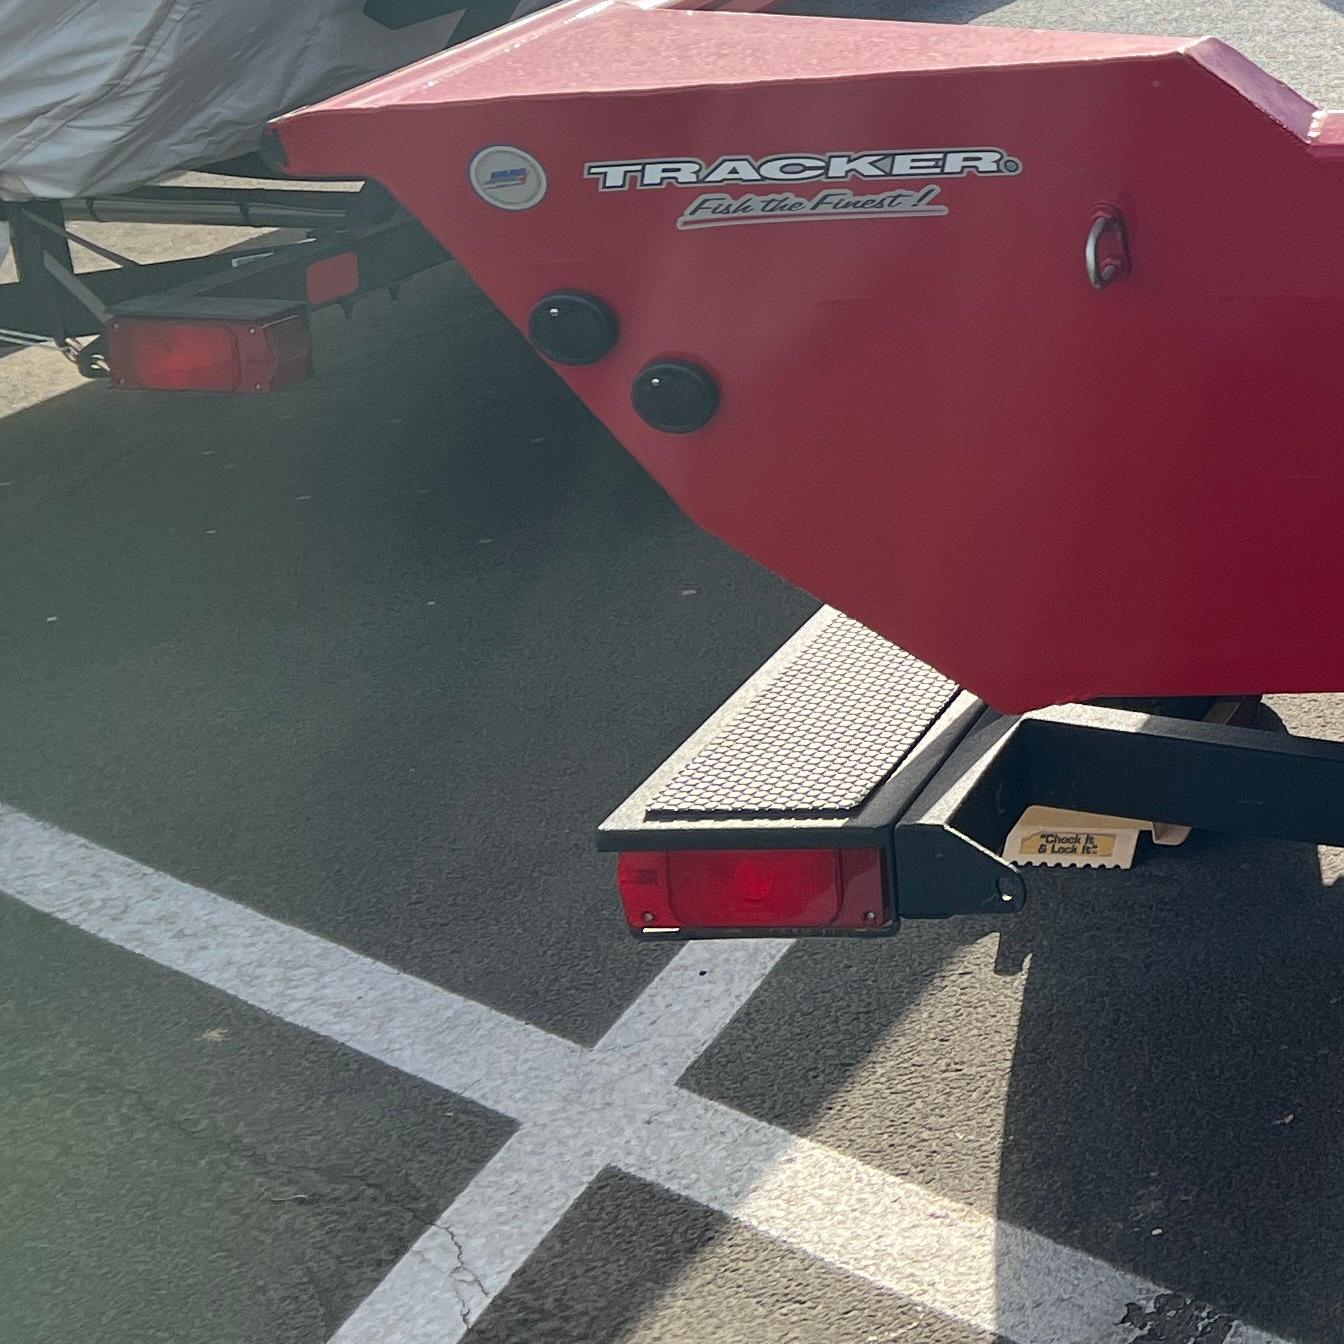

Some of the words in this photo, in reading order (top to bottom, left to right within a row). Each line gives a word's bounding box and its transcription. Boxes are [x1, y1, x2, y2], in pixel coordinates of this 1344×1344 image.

[588, 151, 1004, 189] TRACKER
[689, 198, 752, 217] Fish
[761, 194, 802, 214] the
[1051, 844, 1078, 854] Lock
